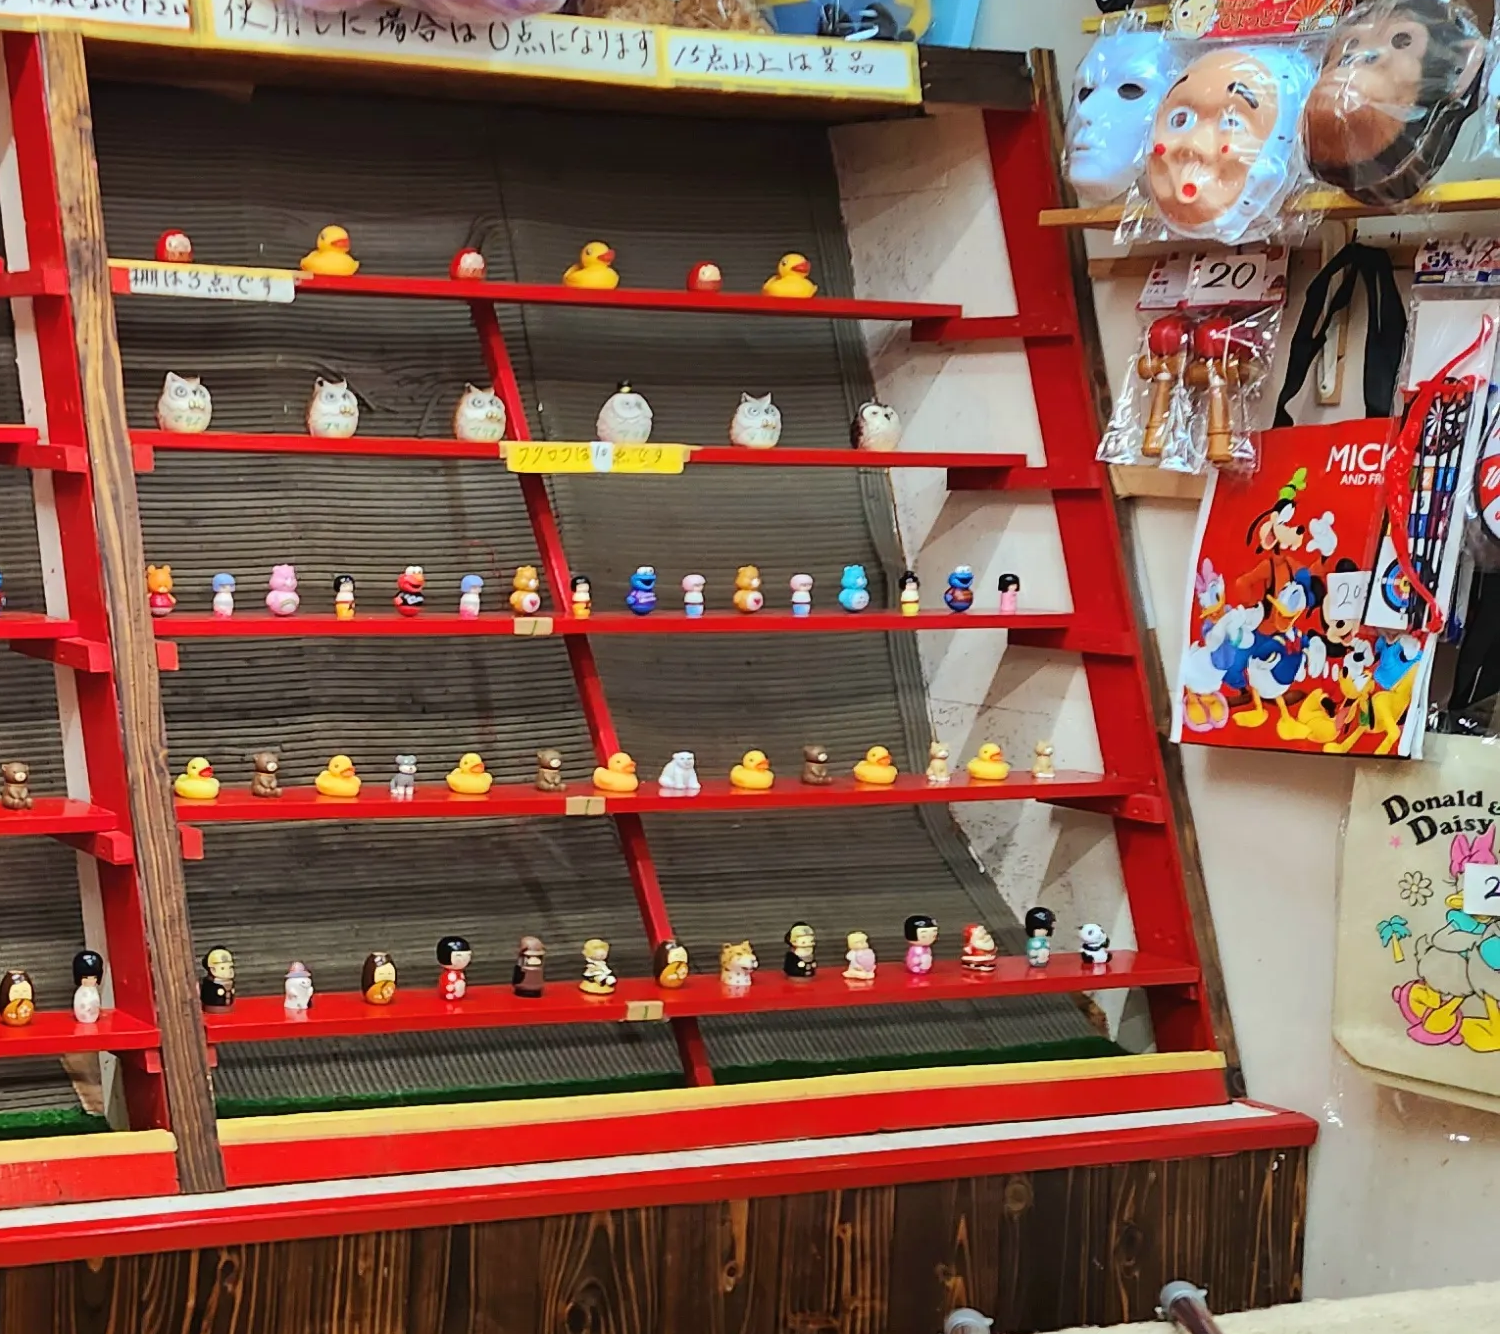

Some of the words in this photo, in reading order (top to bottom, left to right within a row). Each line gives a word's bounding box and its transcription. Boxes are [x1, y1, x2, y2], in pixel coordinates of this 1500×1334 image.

[1201, 262, 1257, 290] 20
[1325, 443, 1397, 473] MICK
[1340, 473, 1366, 485] AND
[1381, 790, 1483, 825] Donald
[1406, 815, 1494, 846] Daisy
[1484, 876, 1500, 900] 2
